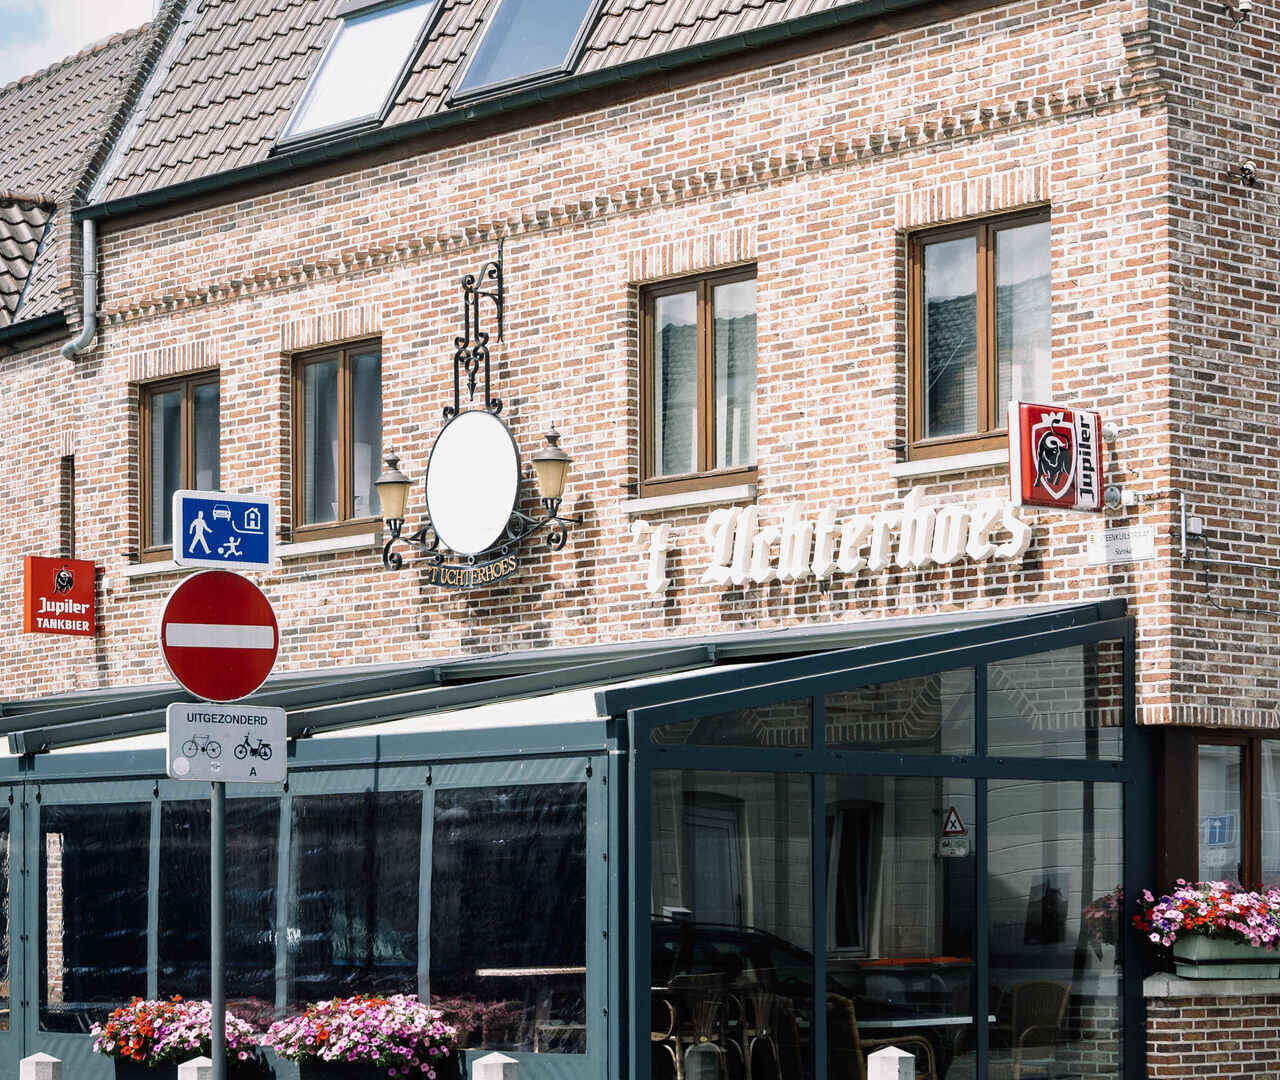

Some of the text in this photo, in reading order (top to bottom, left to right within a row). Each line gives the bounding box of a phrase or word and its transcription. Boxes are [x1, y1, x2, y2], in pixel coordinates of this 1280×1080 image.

[1079, 414, 1096, 504] Jupiler
[440, 554, 517, 586] UCHTERHOES
[37, 597, 90, 616] Jupiler
[36, 617, 90, 631] TANKBIER
[186, 712, 269, 726] UITGEZONDERD
[249, 767, 257, 777] A
